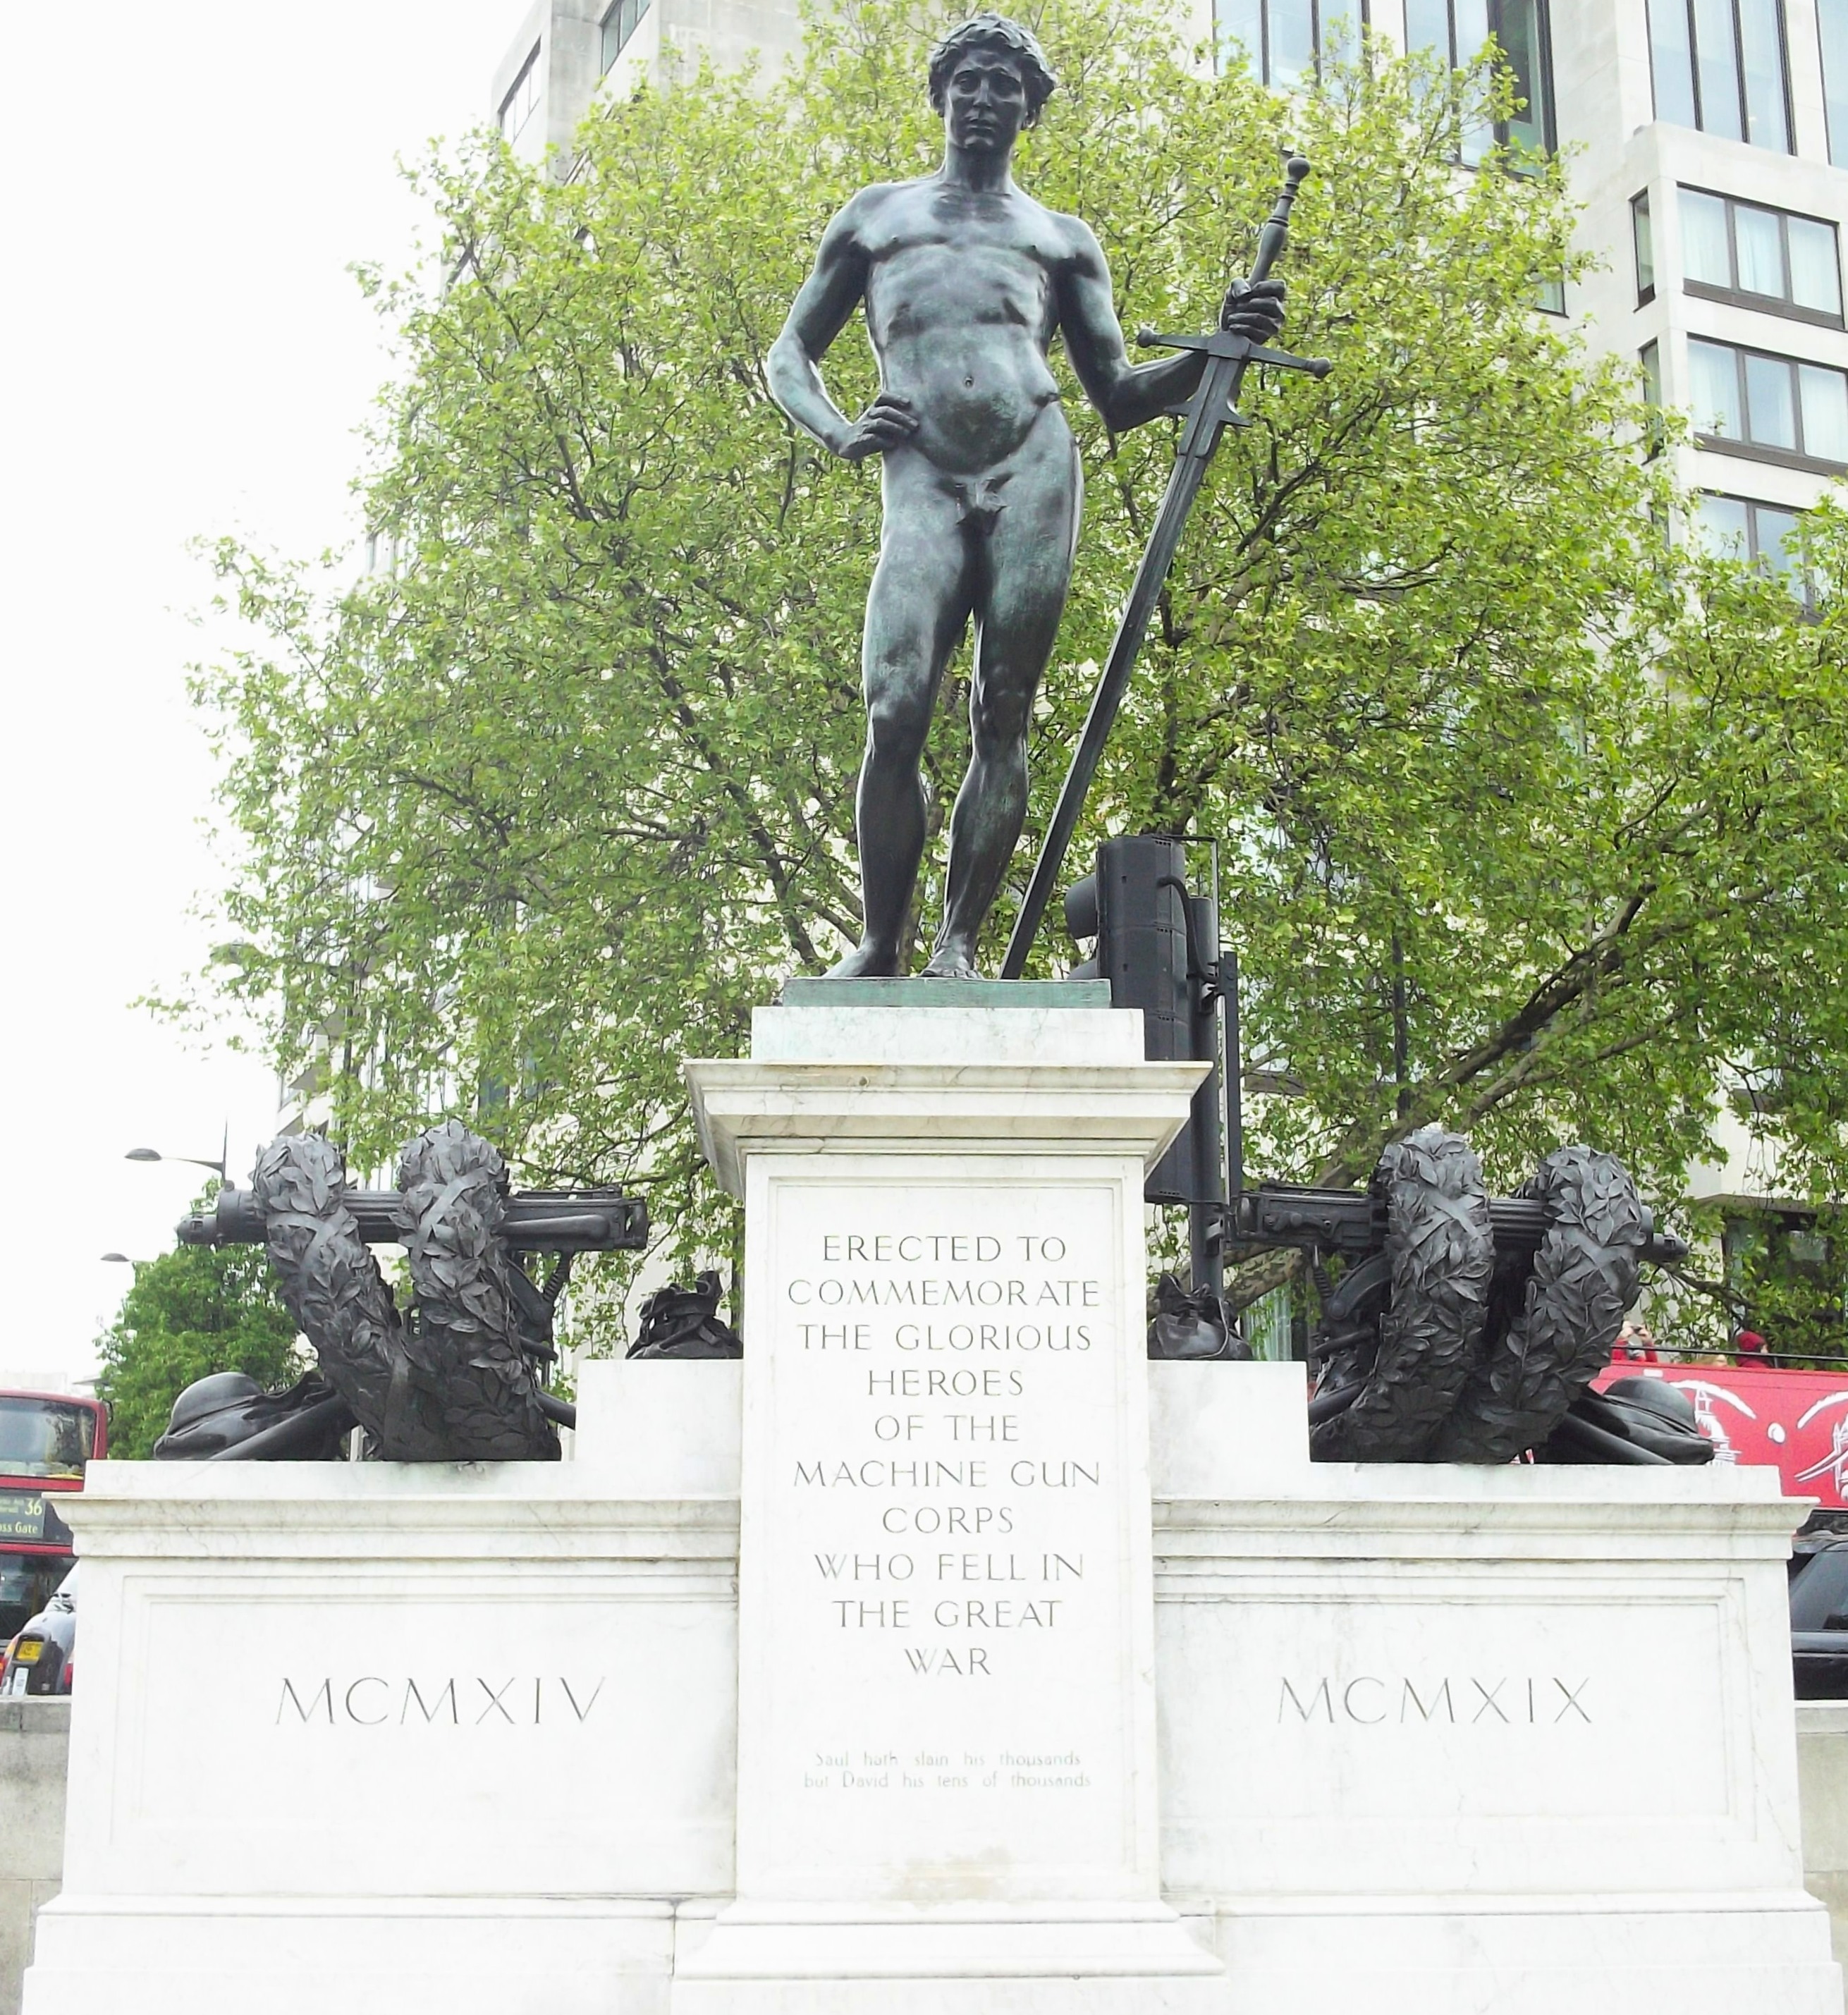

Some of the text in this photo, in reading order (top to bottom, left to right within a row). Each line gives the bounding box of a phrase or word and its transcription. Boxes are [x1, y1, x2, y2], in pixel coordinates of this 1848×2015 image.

[822, 1235, 1067, 1263] ERECTED TO
[788, 1279, 1101, 1307] COMMEMORATE
[797, 1323, 1091, 1352] THE GLORIOUS
[867, 1368, 1024, 1397] HEROES
[874, 1414, 1020, 1443] OF THE
[793, 1459, 1100, 1488] MACHINE GUN
[25, 1498, 42, 1515] 36
[882, 1506, 1014, 1534] CORPS
[16, 1521, 38, 1533] Gate
[813, 1553, 1084, 1581] WHO FELL IN
[831, 1600, 1063, 1629] THE GREAT
[903, 1647, 992, 1676] WAR
[276, 1677, 605, 1725] MCMXIV
[1278, 1677, 1592, 1724] MCMXIX
[815, 1750, 1082, 1768] Saul hath slain his thousands
[804, 1770, 1092, 1789] but David his tens of thousands
